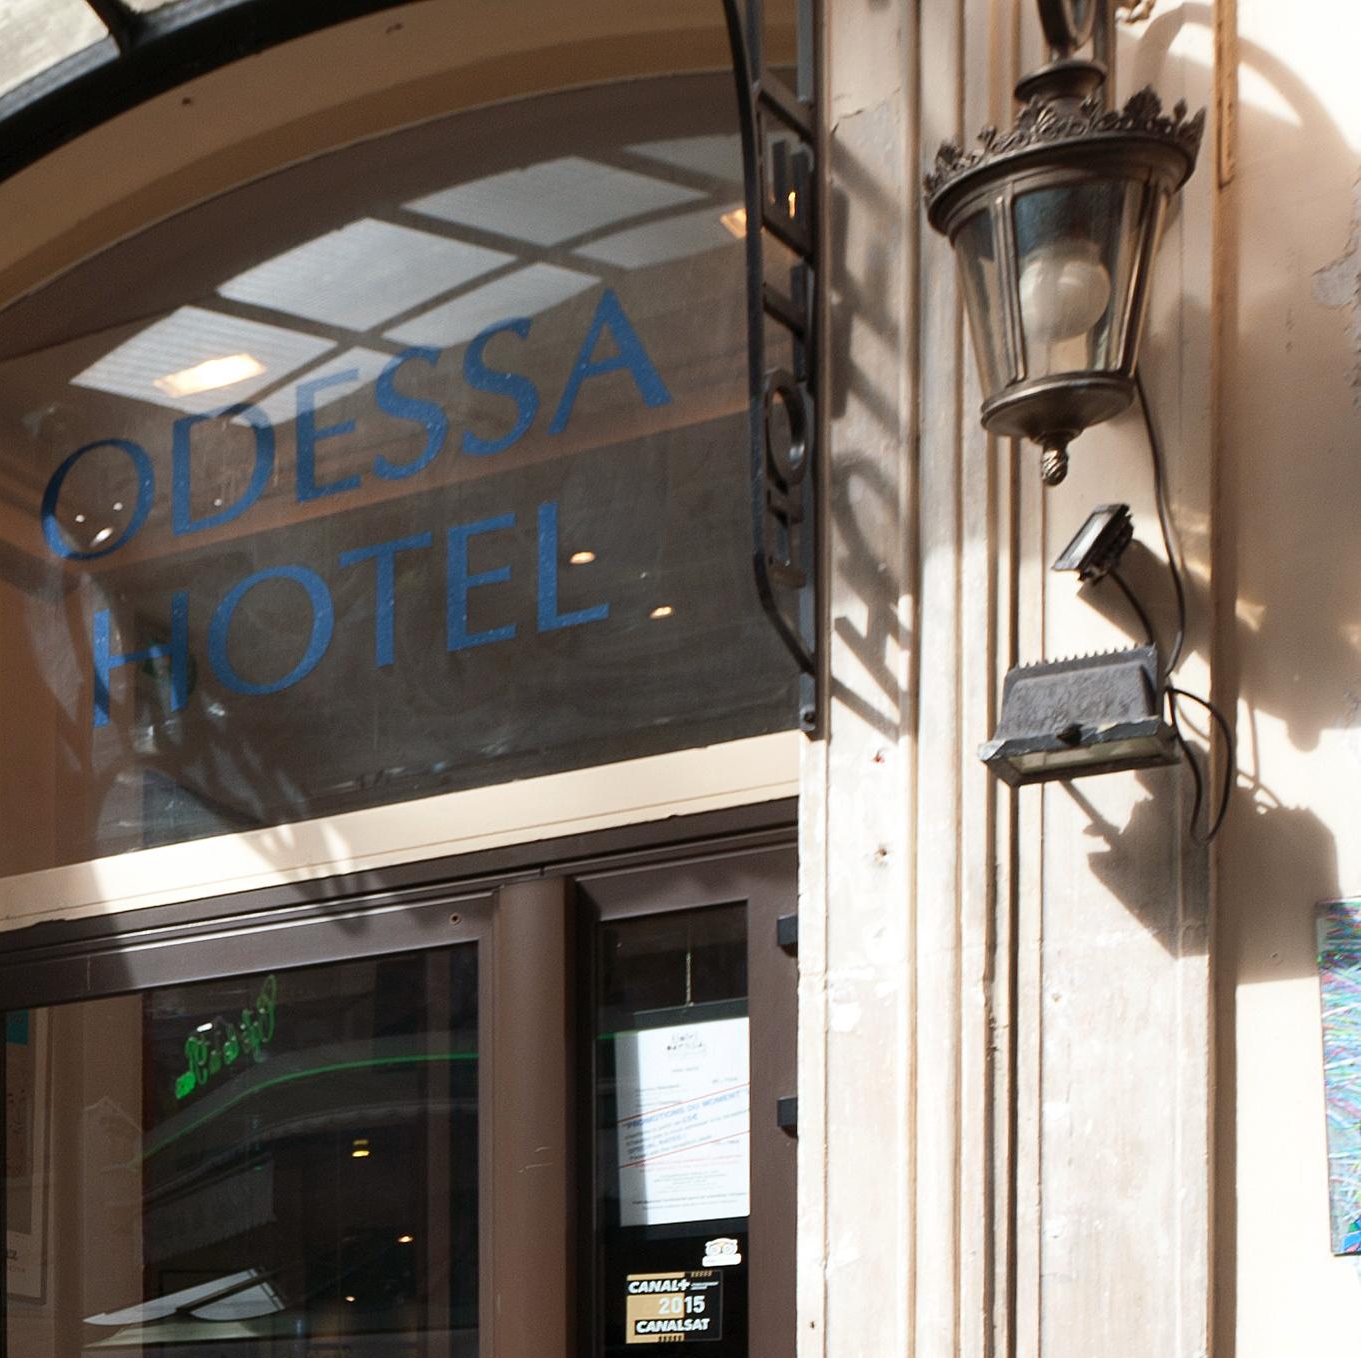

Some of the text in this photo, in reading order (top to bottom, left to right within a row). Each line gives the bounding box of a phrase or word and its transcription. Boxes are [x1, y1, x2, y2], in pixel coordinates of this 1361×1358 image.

[40, 288, 673, 561] ODESSA
[92, 501, 611, 728] HOTEL
[628, 1278, 690, 1294] CANAL+
[659, 1295, 706, 1315] 2015
[635, 1318, 710, 1334] CANALSAT
